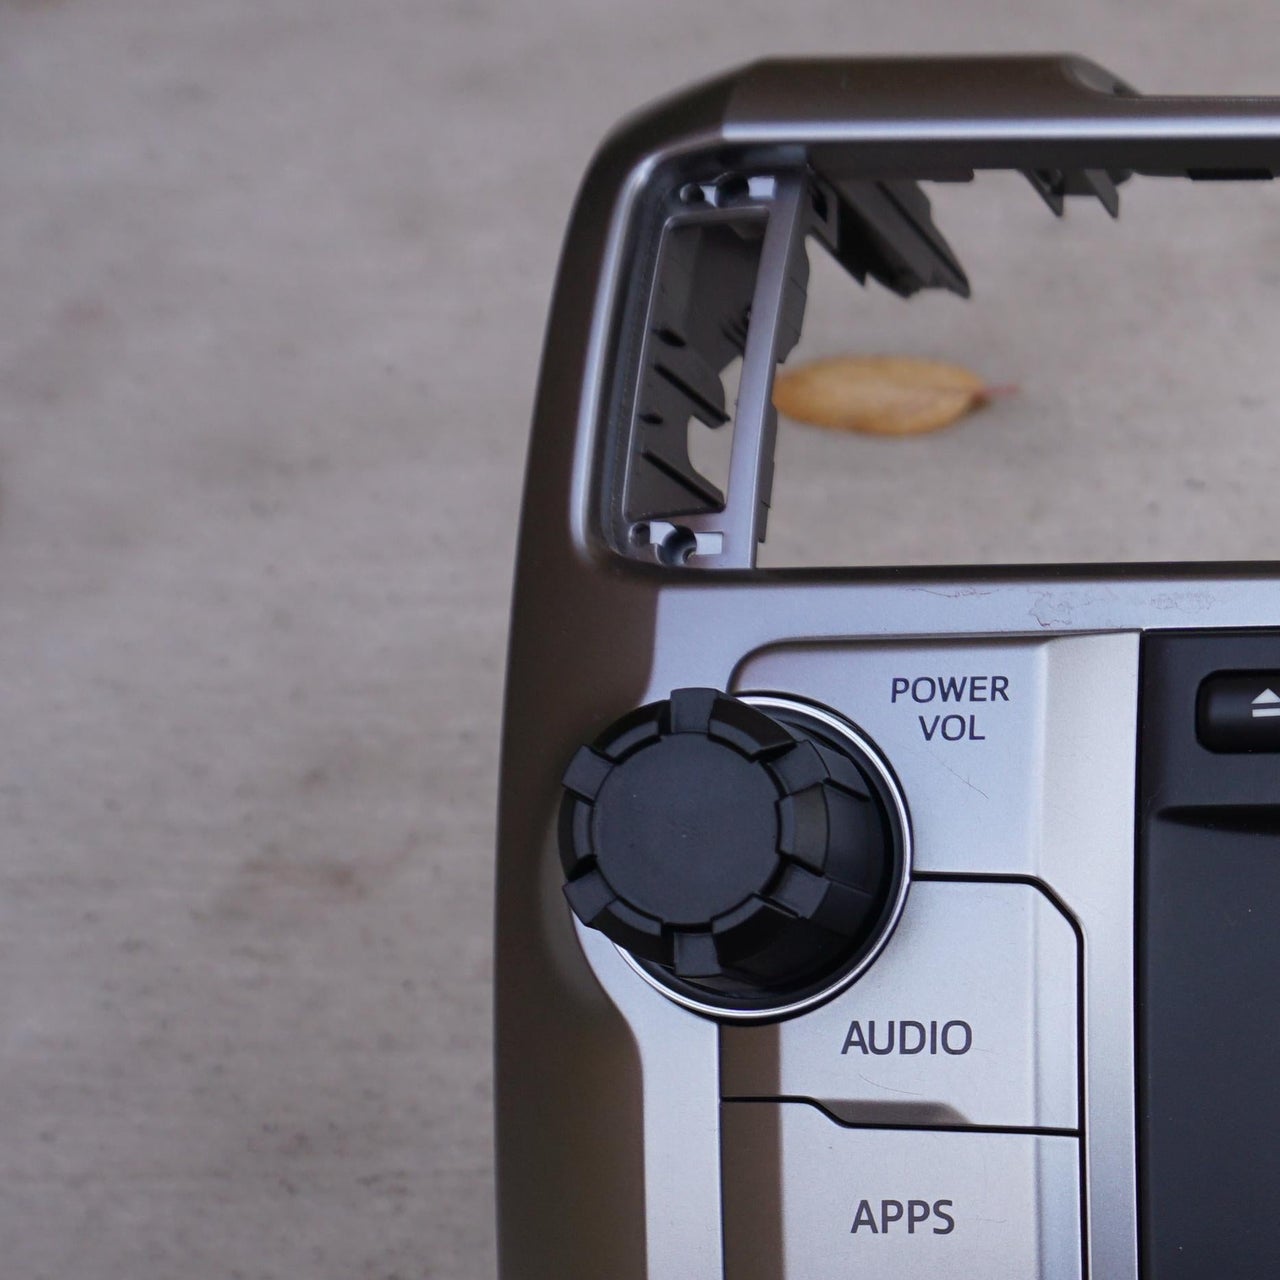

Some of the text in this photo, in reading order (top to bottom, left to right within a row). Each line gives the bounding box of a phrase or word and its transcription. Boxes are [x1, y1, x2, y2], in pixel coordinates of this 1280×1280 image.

[891, 675, 1009, 703] POWER
[918, 714, 986, 741] VOL
[841, 1019, 973, 1055] AUDIO
[850, 1200, 956, 1234] APPS
